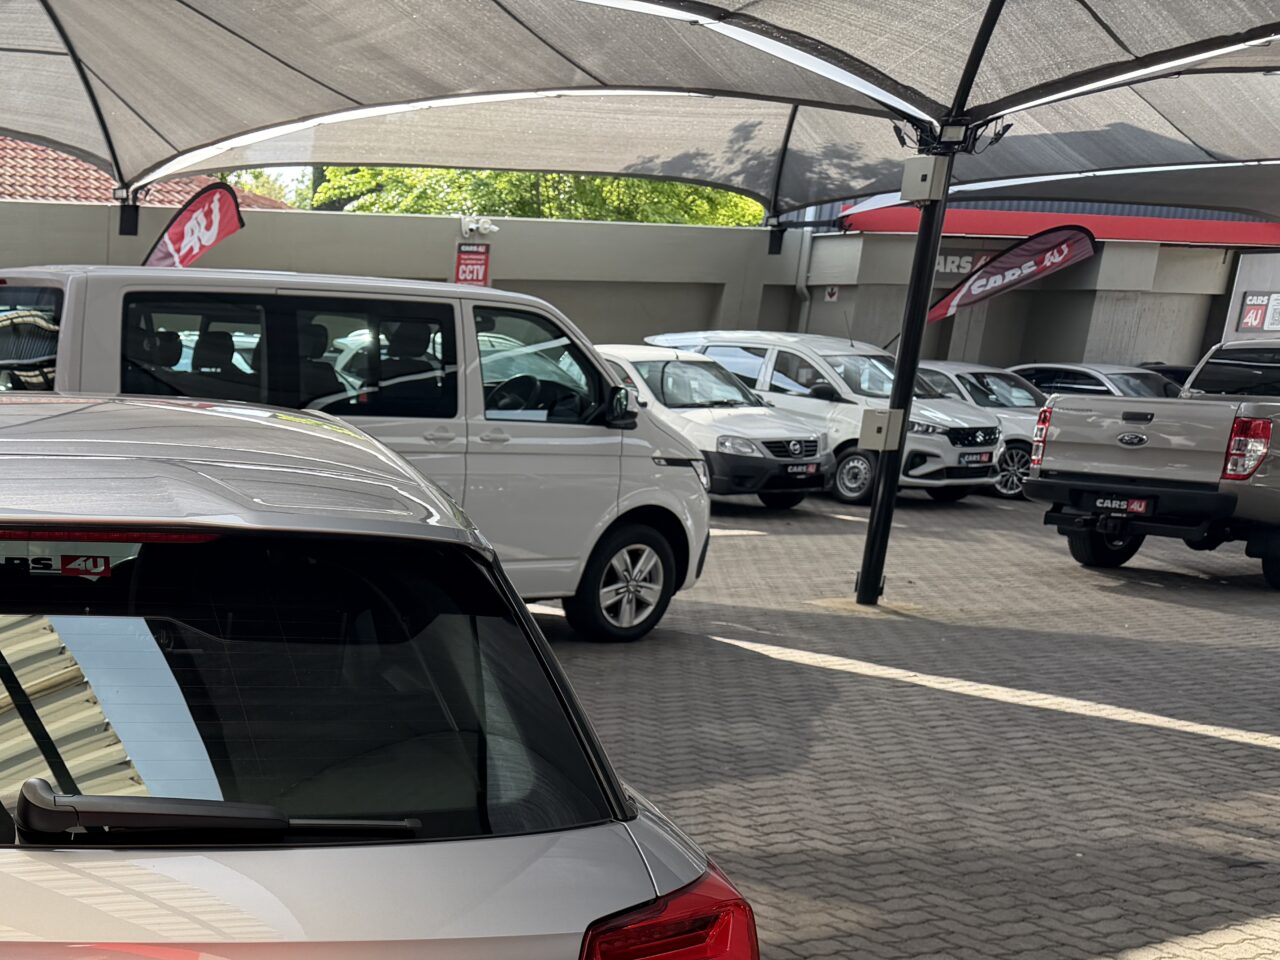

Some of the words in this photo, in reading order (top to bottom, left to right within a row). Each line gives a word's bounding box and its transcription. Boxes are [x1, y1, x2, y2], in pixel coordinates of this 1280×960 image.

[458, 264, 486, 280] CCTV
[970, 261, 1038, 295] CARS
[1246, 295, 1270, 305] CARS
[1243, 309, 1263, 327] 4U
[1096, 499, 1128, 509] CARS
[1130, 501, 1146, 511] 4U
[65, 556, 107, 573] 4U
